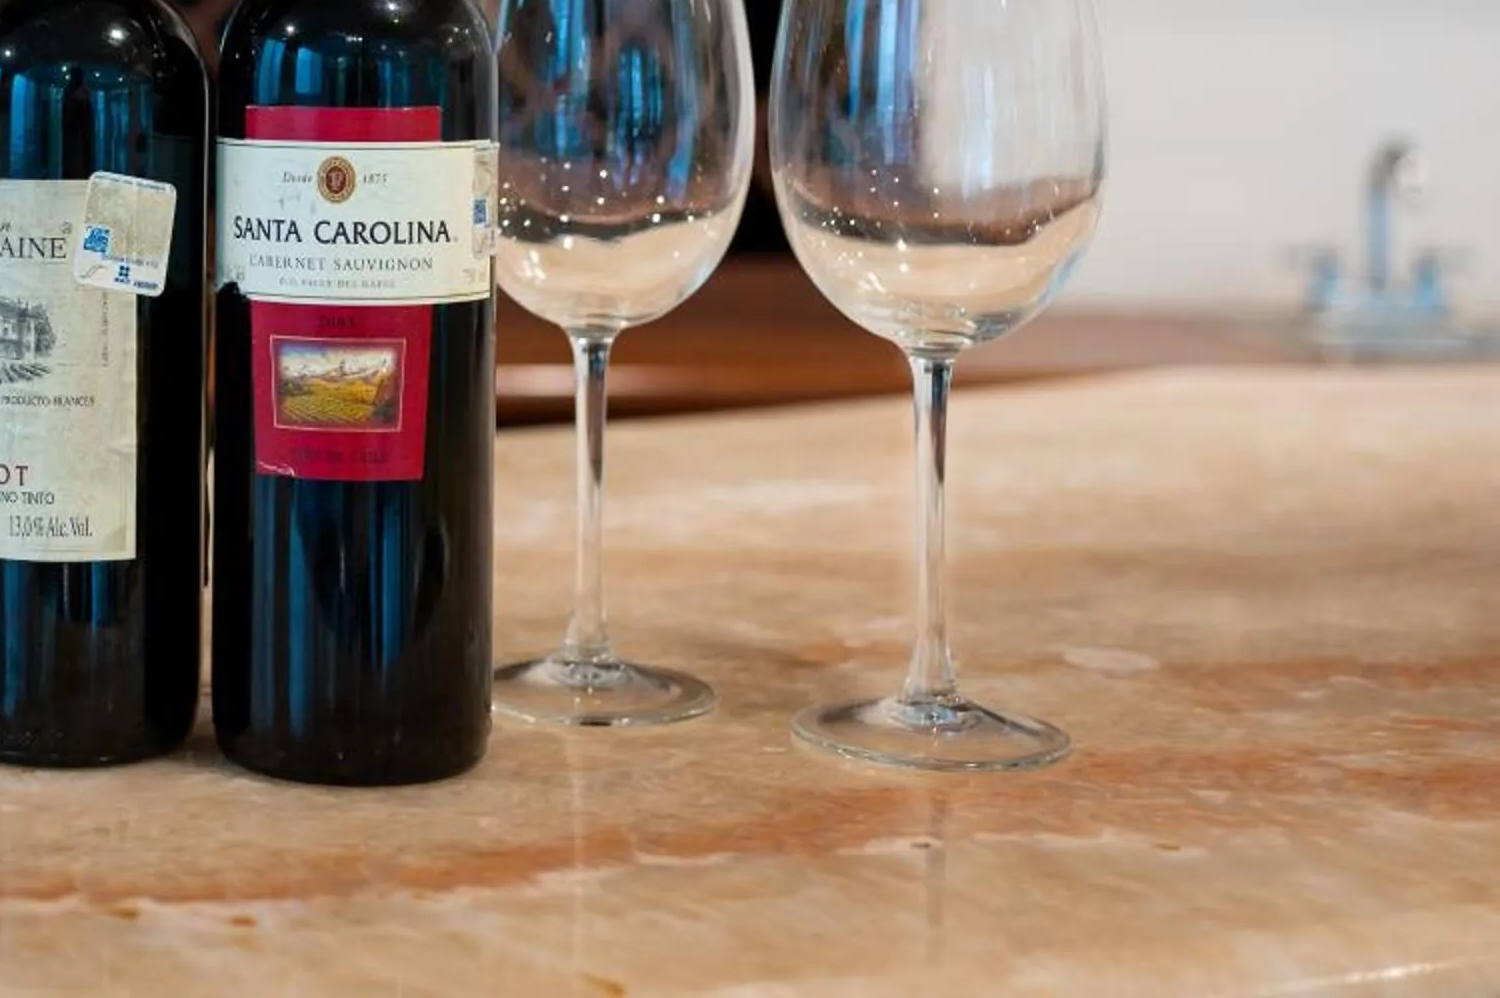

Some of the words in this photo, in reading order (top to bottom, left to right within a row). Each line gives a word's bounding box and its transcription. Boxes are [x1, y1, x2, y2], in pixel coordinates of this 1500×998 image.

[233, 215, 302, 243] SANTA
[313, 219, 452, 245] CAROLINA
[249, 253, 326, 271] CABERNET
[333, 257, 434, 271] SAUVIGNON
[19, 491, 55, 505] TINTO
